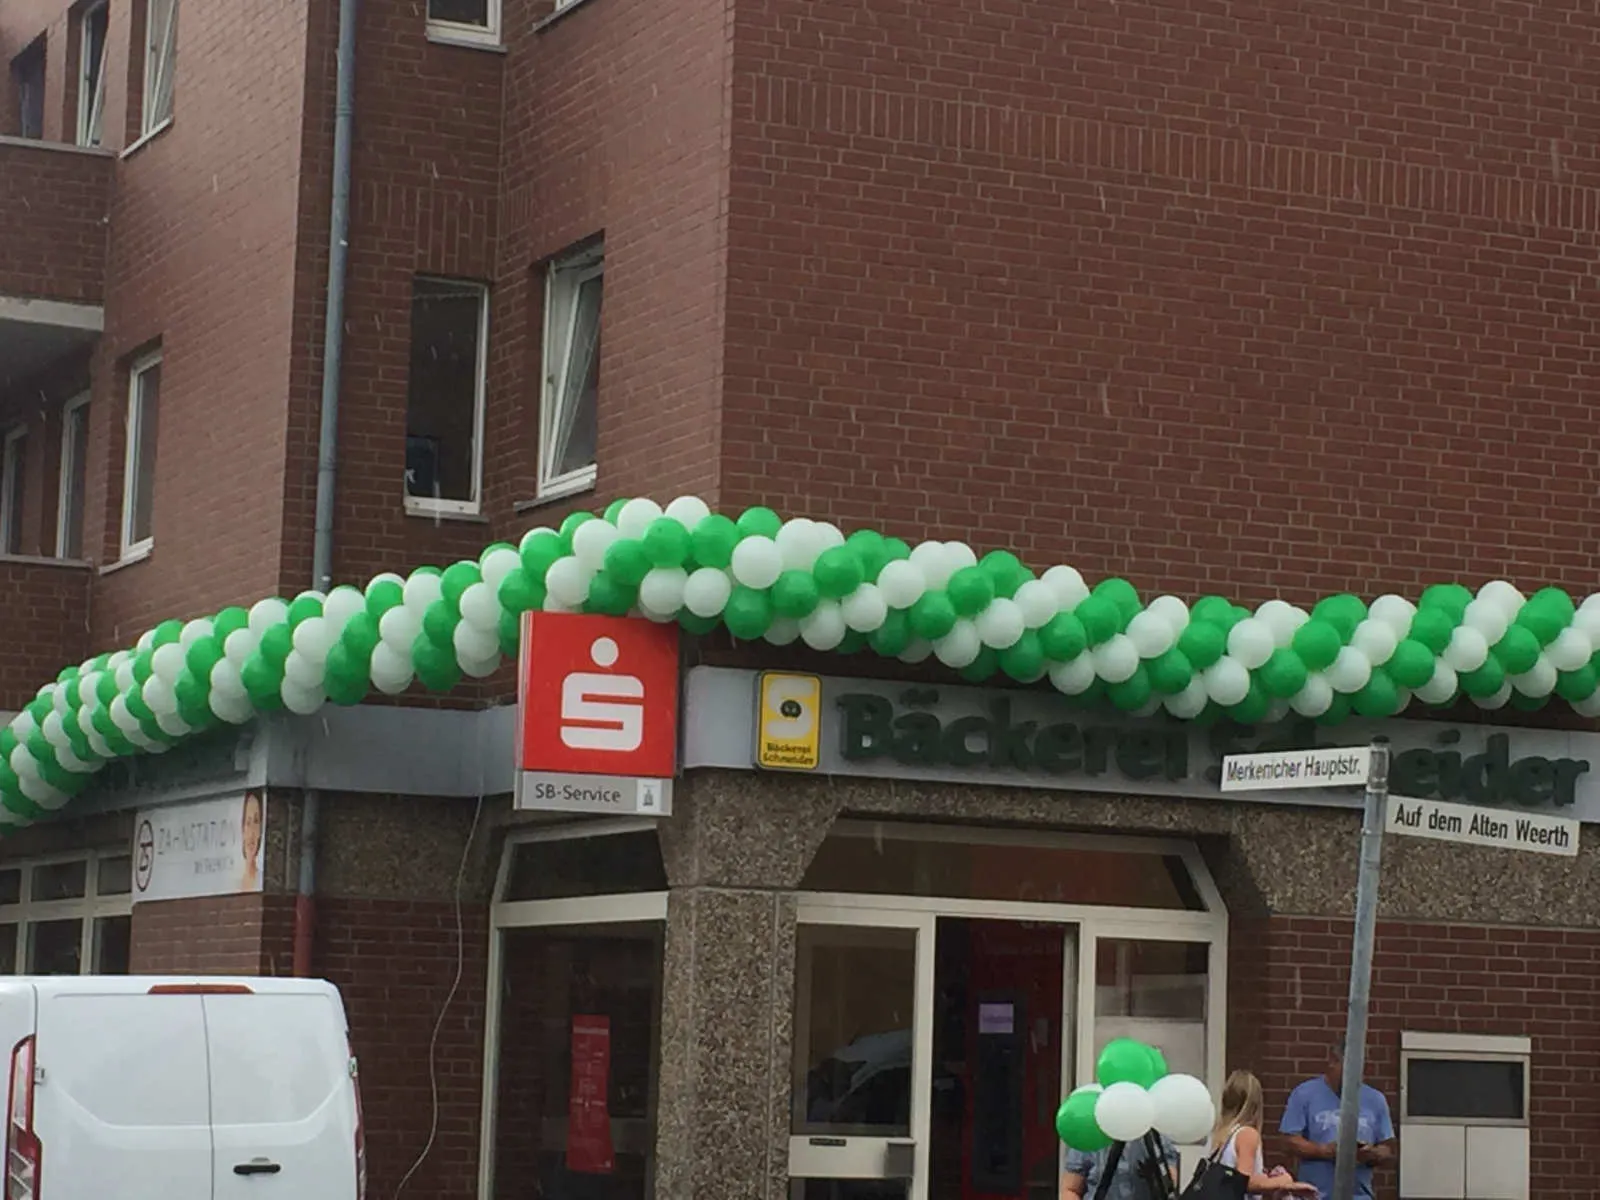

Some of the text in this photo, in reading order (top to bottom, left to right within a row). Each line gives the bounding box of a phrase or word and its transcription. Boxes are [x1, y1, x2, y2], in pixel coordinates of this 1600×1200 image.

[838, 687, 1188, 782] Bäckerei
[1226, 755, 1361, 782] Merkenicher Hauptstr.
[535, 783, 621, 803] SB-Service
[1395, 803, 1569, 848] Auf dem Alten Weerth
